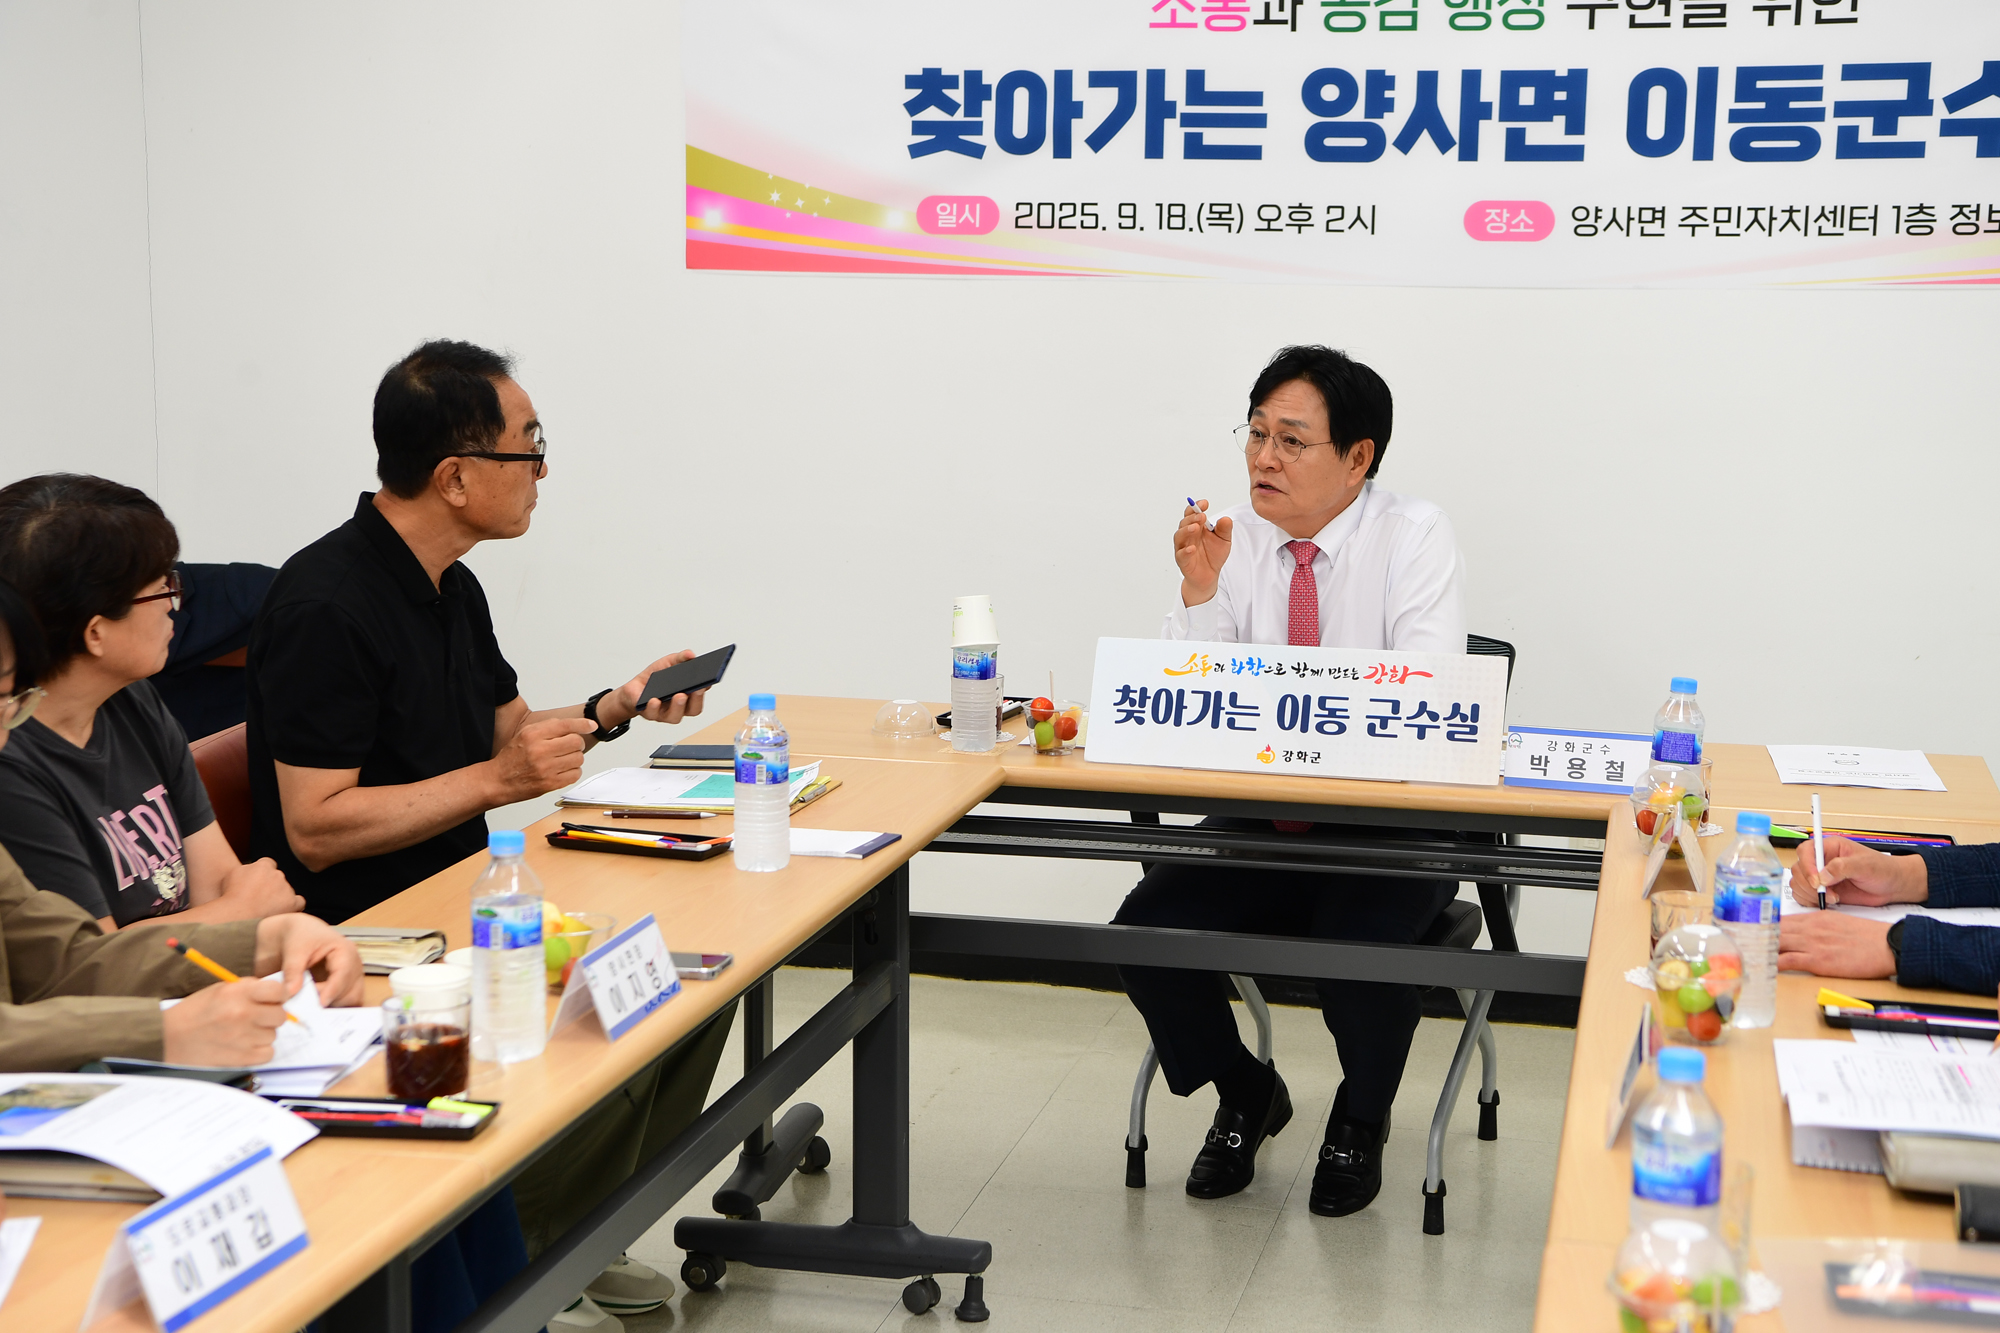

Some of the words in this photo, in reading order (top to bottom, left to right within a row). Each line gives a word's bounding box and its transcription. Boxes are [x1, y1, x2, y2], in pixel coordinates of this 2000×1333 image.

[903, 68, 1267, 160] 찾아가는
[1301, 68, 1588, 163] 양사면
[935, 202, 981, 229] 일시
[1015, 202, 1106, 231] 2025.
[1118, 203, 1144, 231] 9.
[1254, 203, 1314, 234] 오후
[1326, 205, 1376, 235] 2시
[1484, 208, 1535, 234] 장소
[1572, 206, 1666, 237] 양사면
[1678, 205, 1878, 237] 주민자치센터
[1892, 203, 1937, 236] 1층
[1163, 652, 1226, 678] 소통과
[1231, 656, 1287, 677] 화합으로
[1291, 661, 1324, 679] 함께
[1328, 666, 1360, 681] 만드는
[1363, 662, 1434, 685] 강화
[1112, 684, 1260, 731] 찾아가는
[1277, 694, 1350, 735] 이동
[1366, 698, 1480, 743] 군수실
[1282, 750, 1322, 764] 강화군
[1546, 740, 1611, 756] 강화군수
[1529, 754, 1625, 783] 박용철
